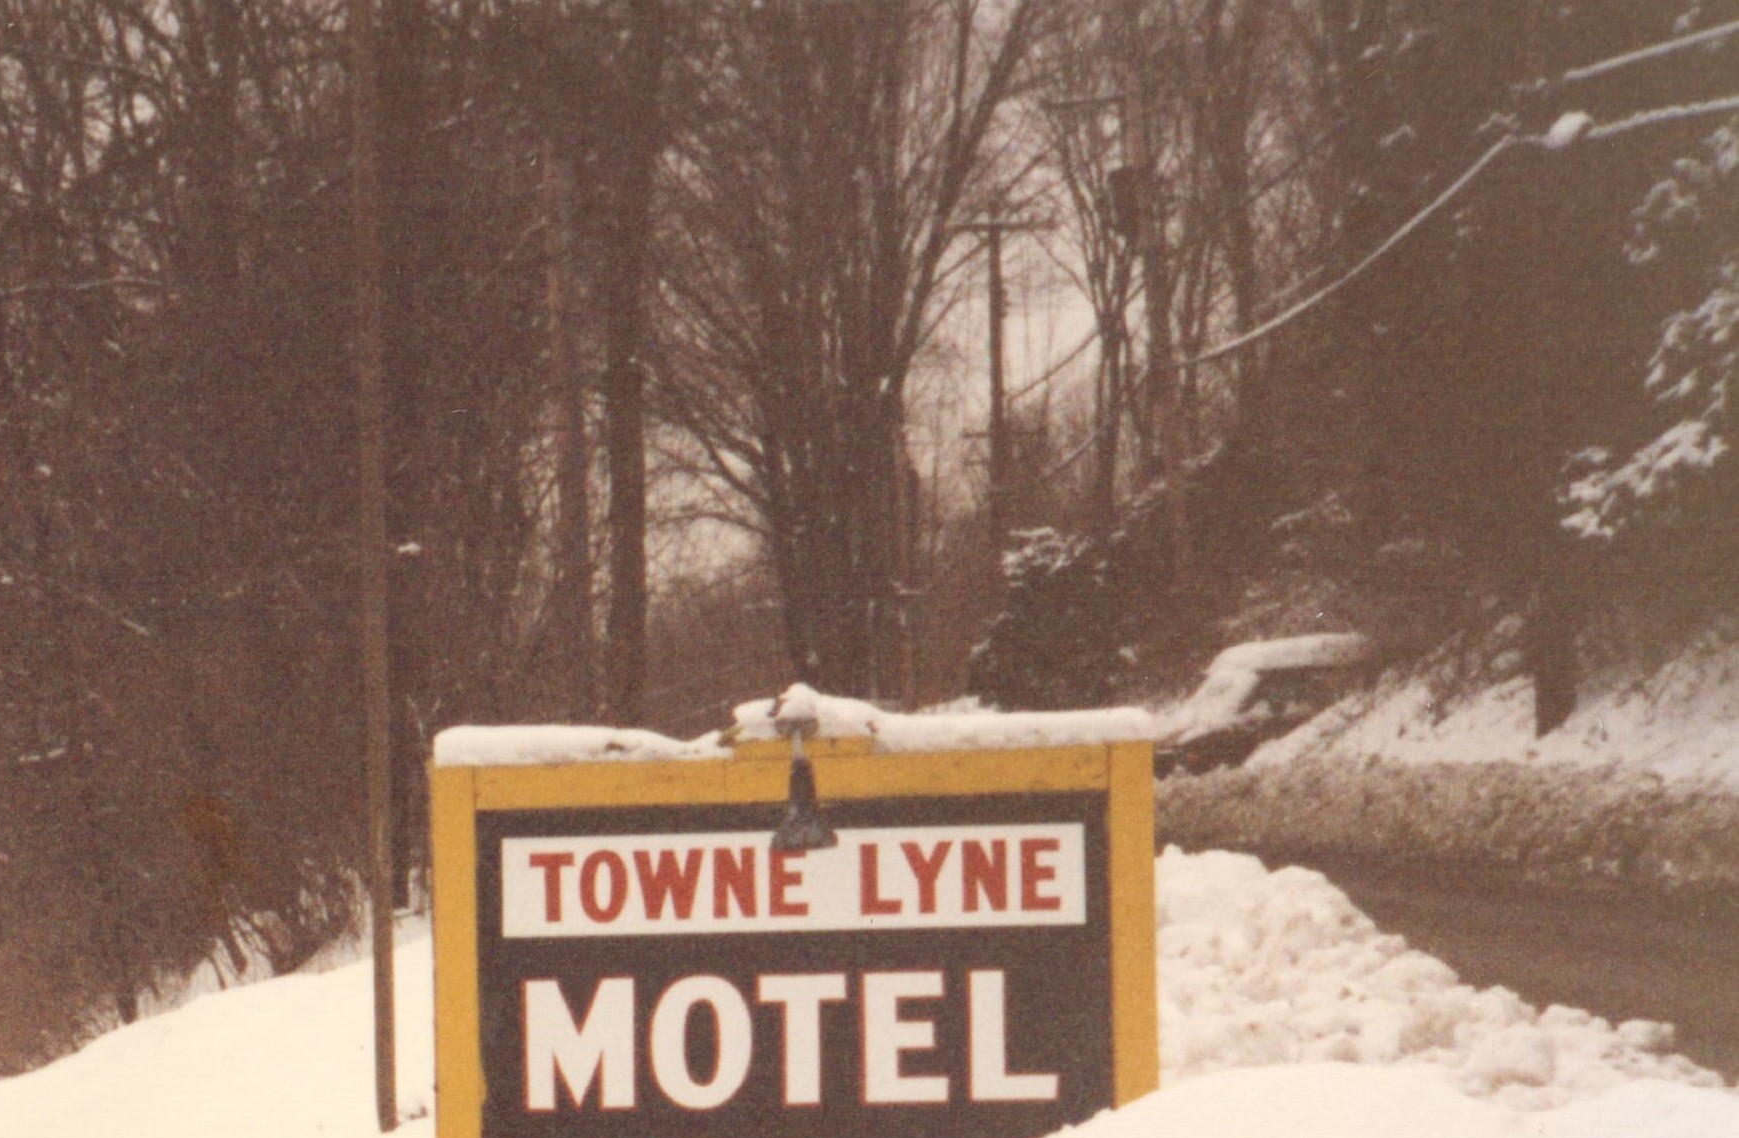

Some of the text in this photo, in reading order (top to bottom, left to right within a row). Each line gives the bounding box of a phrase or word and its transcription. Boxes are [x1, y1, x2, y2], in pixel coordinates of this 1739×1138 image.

[528, 838, 1061, 924] TOWNE LYNE
[523, 969, 1059, 1111] MOTEL
